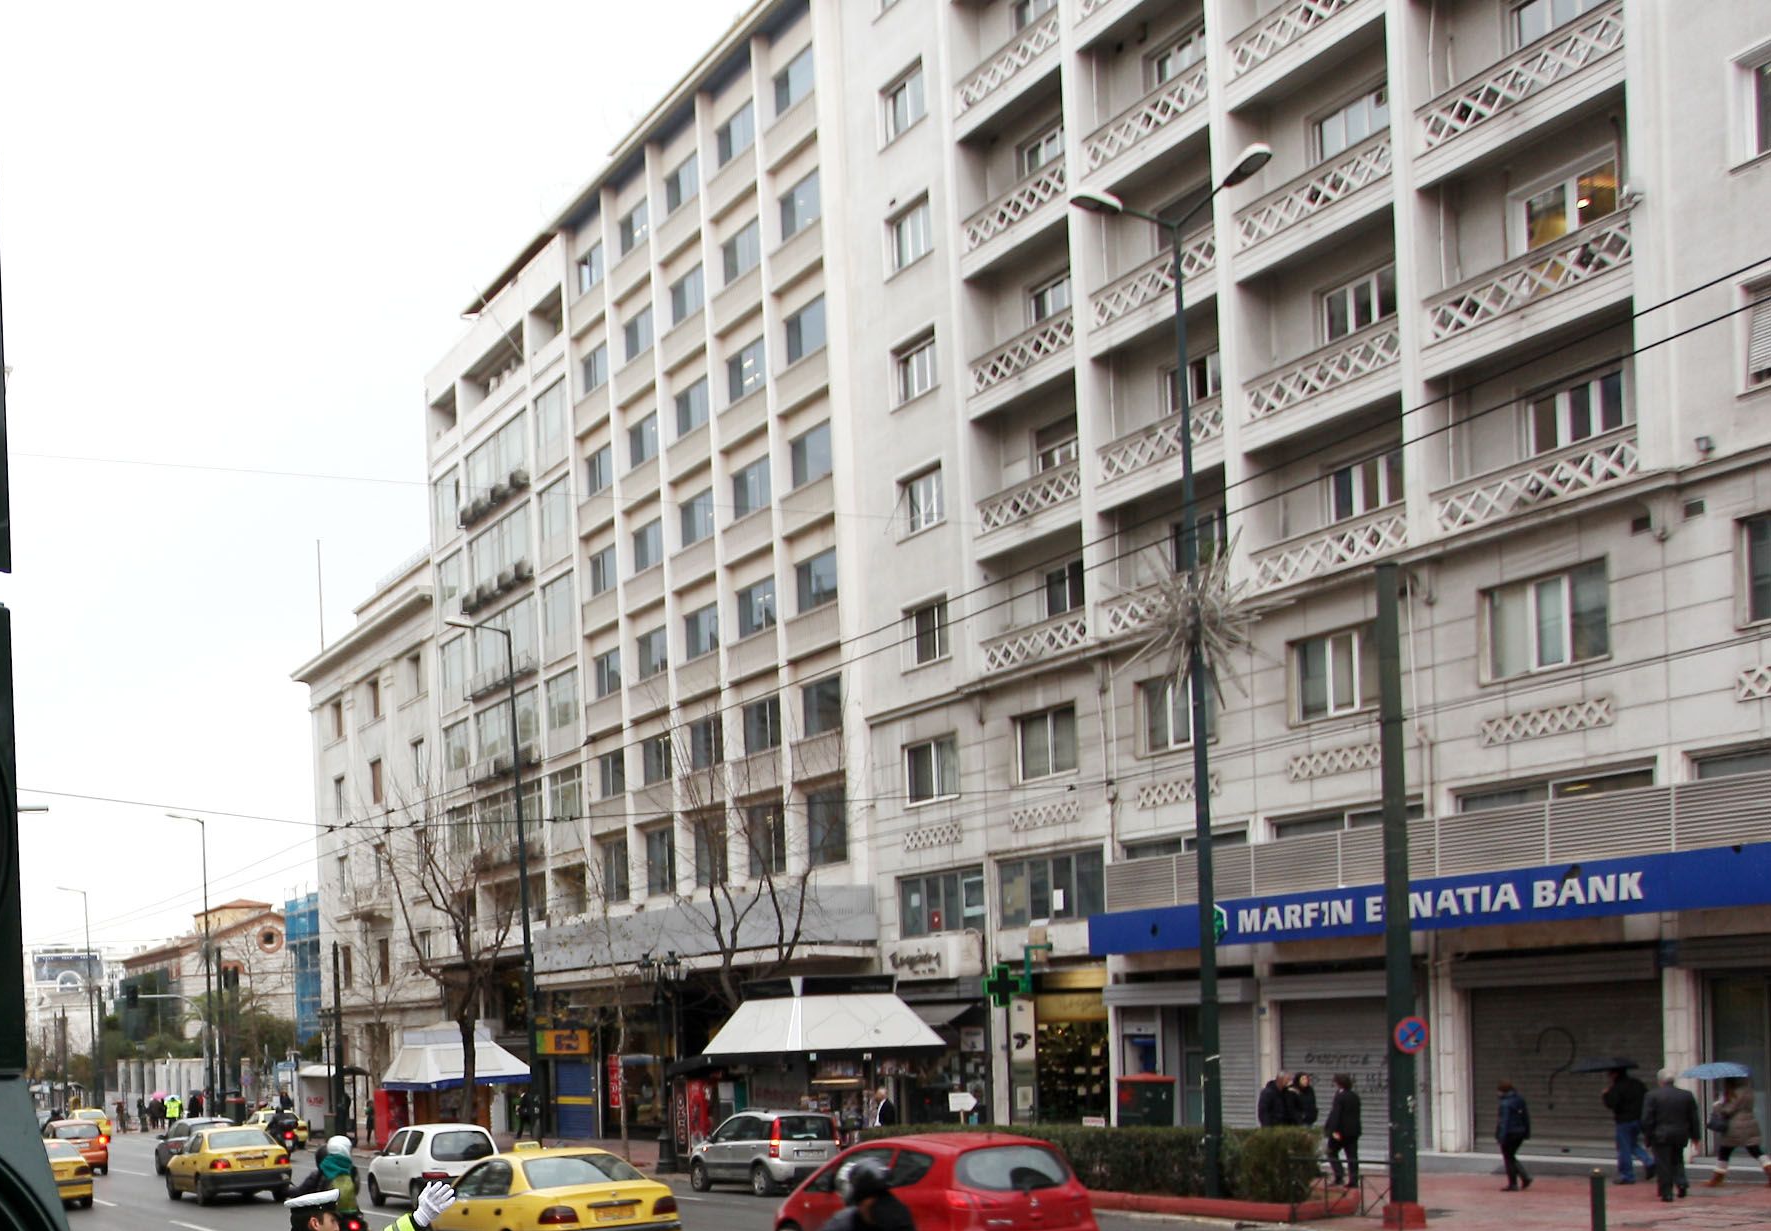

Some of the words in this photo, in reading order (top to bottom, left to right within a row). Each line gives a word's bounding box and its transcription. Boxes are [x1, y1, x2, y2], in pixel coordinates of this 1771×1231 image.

[1238, 898, 1354, 934] MARFIN
[1365, 884, 1521, 923] ENATIA
[1532, 871, 1644, 909] BANK
